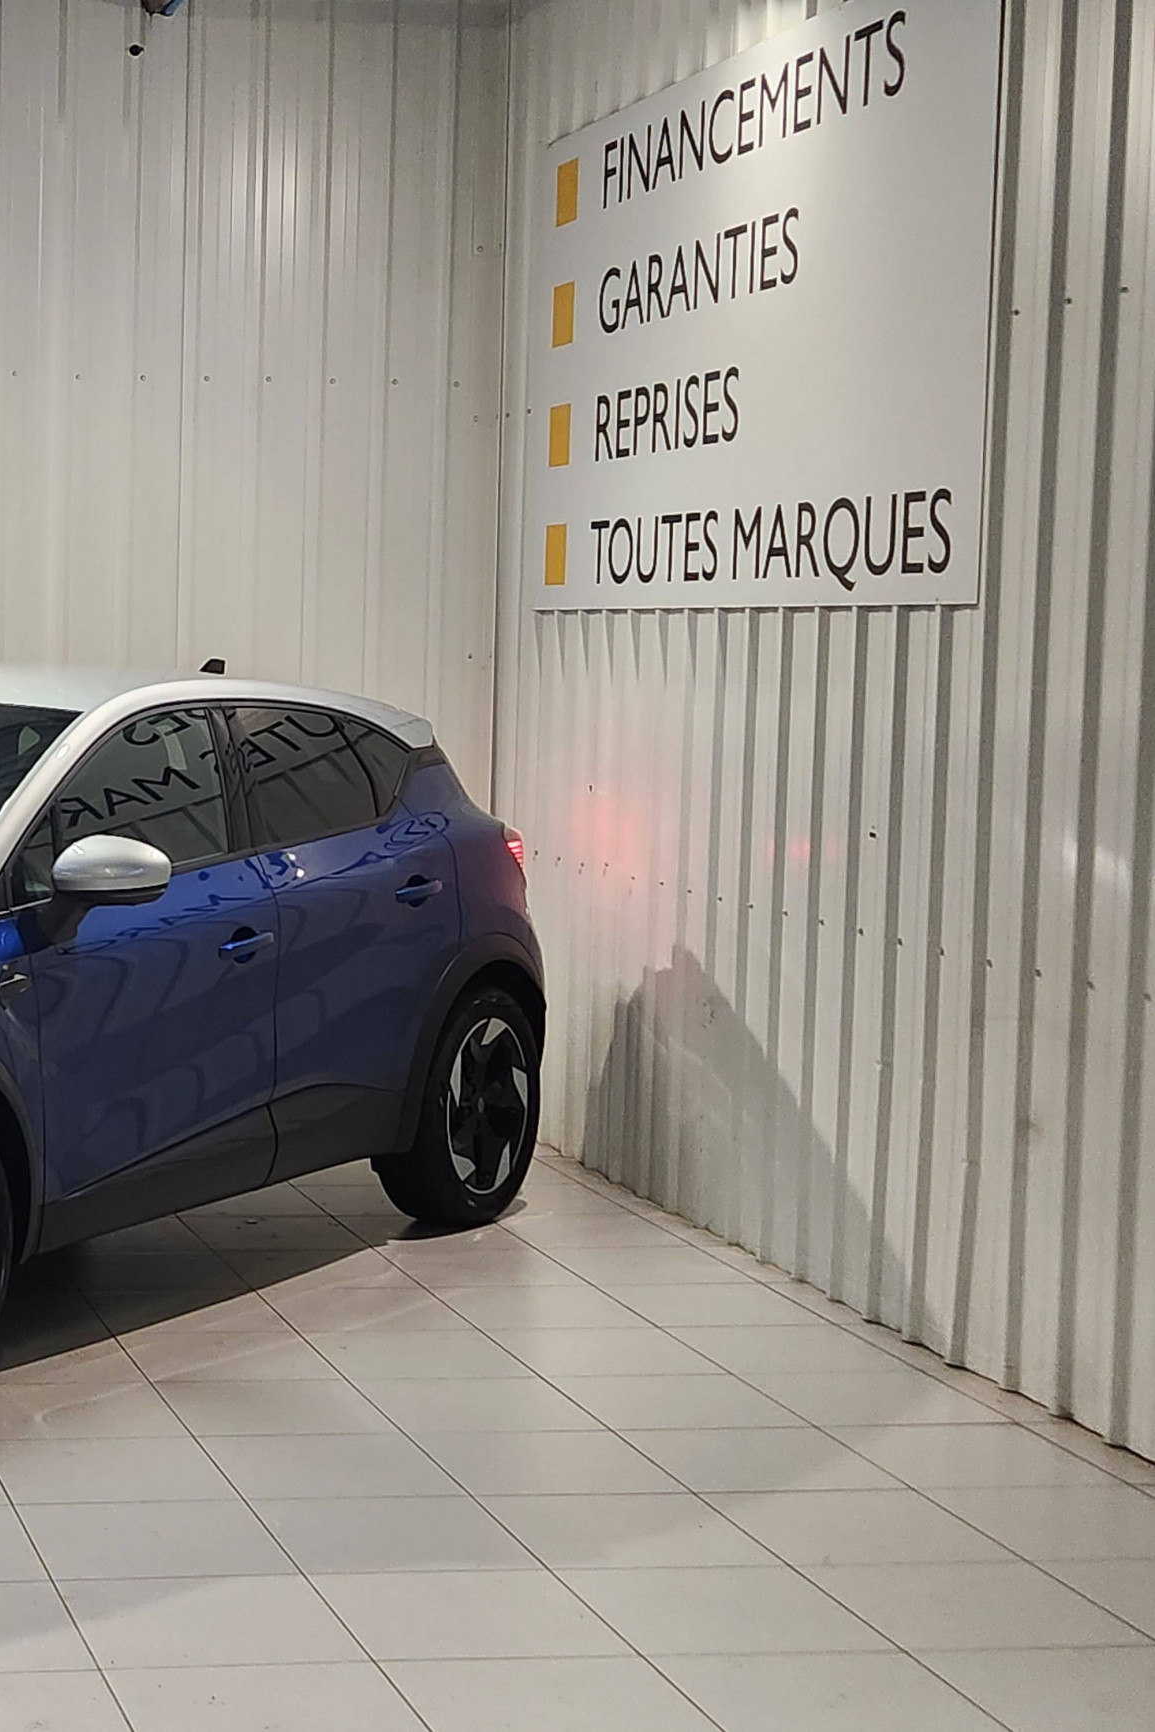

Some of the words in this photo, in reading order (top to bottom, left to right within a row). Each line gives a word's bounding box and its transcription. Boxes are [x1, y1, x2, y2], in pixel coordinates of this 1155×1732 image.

[603, 11, 905, 209] FINANCEMENTS
[600, 208, 798, 333] GARANTIES
[596, 367, 738, 461] REPRISES
[591, 511, 717, 584] TOUTES
[733, 489, 951, 591] MARQUES
